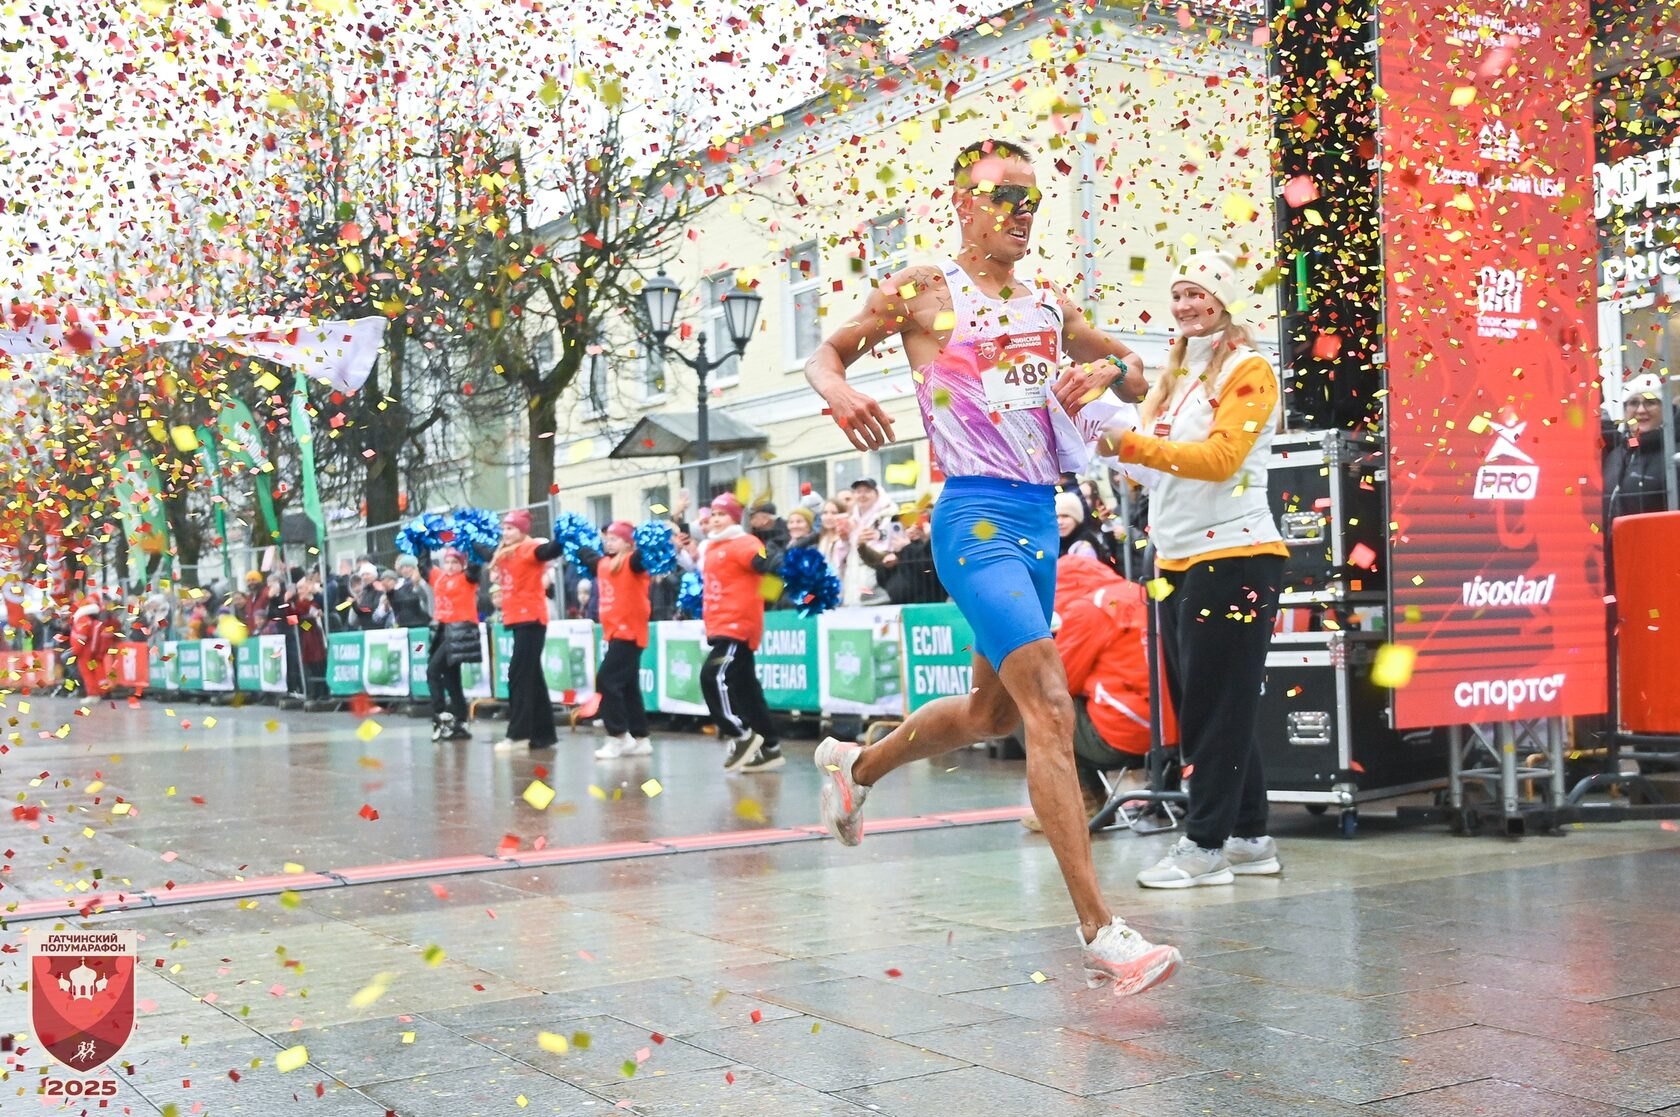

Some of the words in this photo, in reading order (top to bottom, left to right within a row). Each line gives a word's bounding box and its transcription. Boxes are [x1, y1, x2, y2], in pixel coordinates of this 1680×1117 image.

[1004, 362, 1048, 386] 489
[1479, 471, 1532, 494] PRO
[765, 629, 807, 656] САМАЯ
[911, 625, 954, 656] ЕСЛИ
[754, 664, 807, 690] ЕЛЕНАЯ
